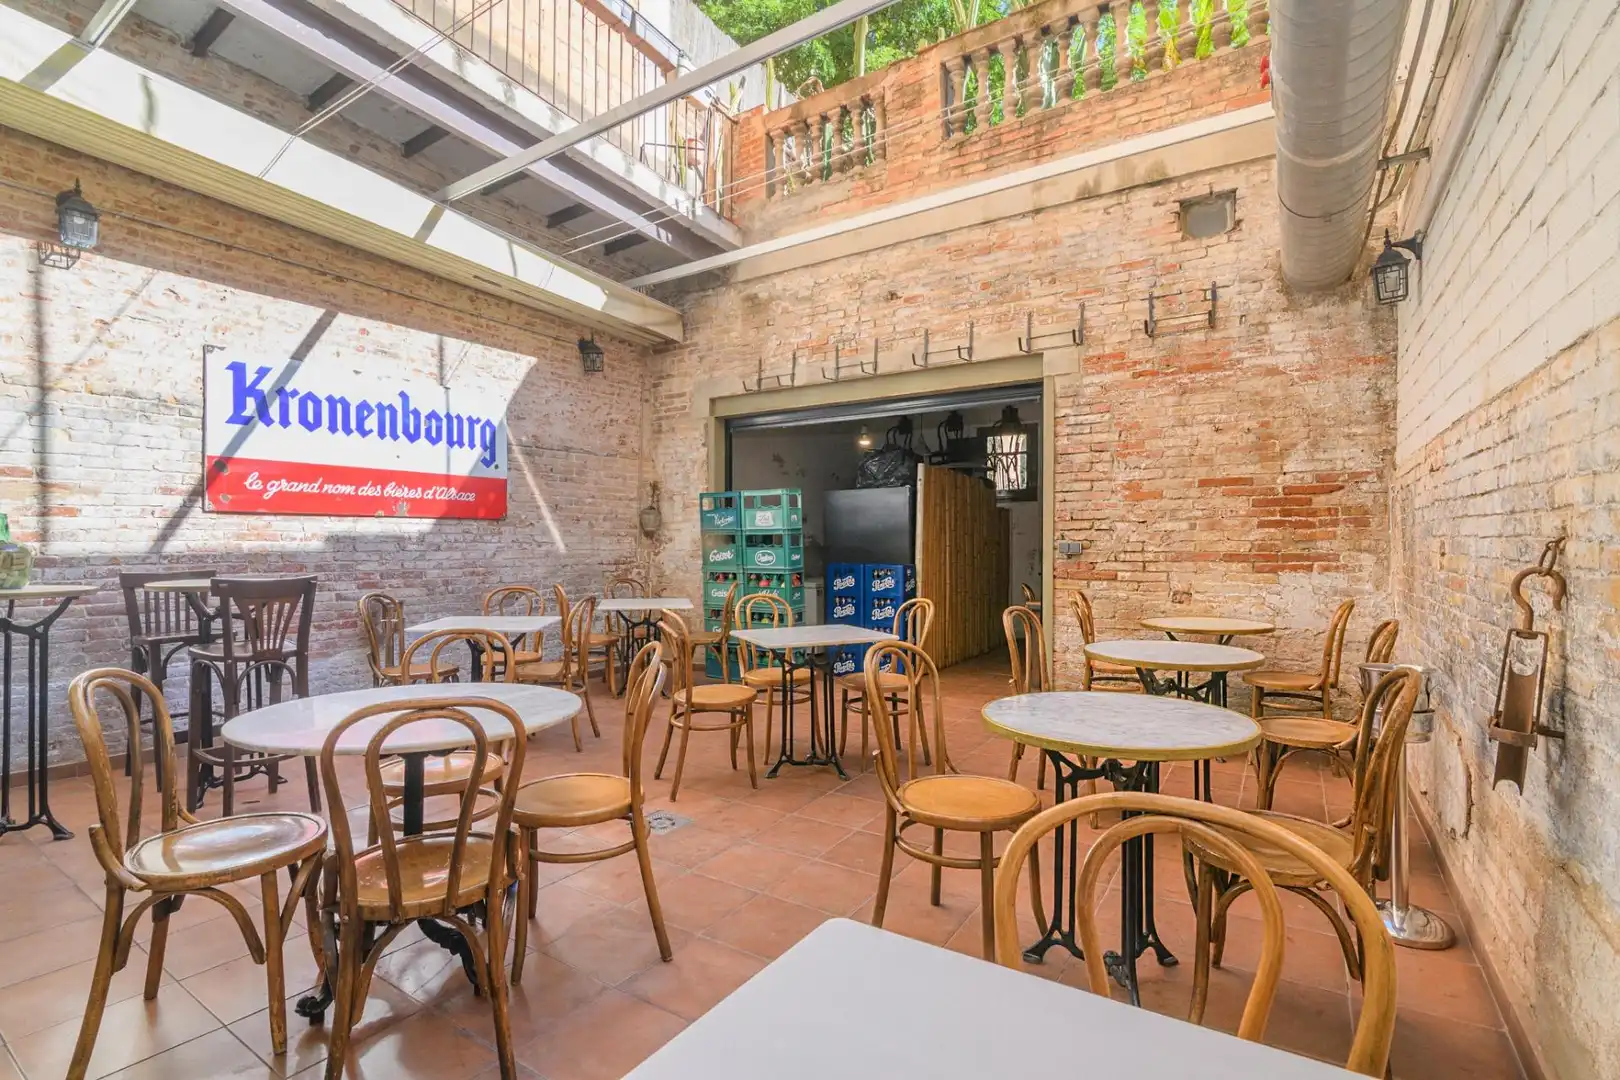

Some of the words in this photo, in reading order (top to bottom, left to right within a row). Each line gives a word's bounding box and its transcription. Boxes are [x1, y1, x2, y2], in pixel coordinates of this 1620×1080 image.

[224, 361, 497, 469] Kronenbourg
[243, 471, 264, 490] le
[263, 477, 323, 500] grand
[322, 483, 356, 495] nom
[358, 480, 382, 496] des
[383, 481, 423, 499] bières
[423, 485, 476, 502] d'Alsace
